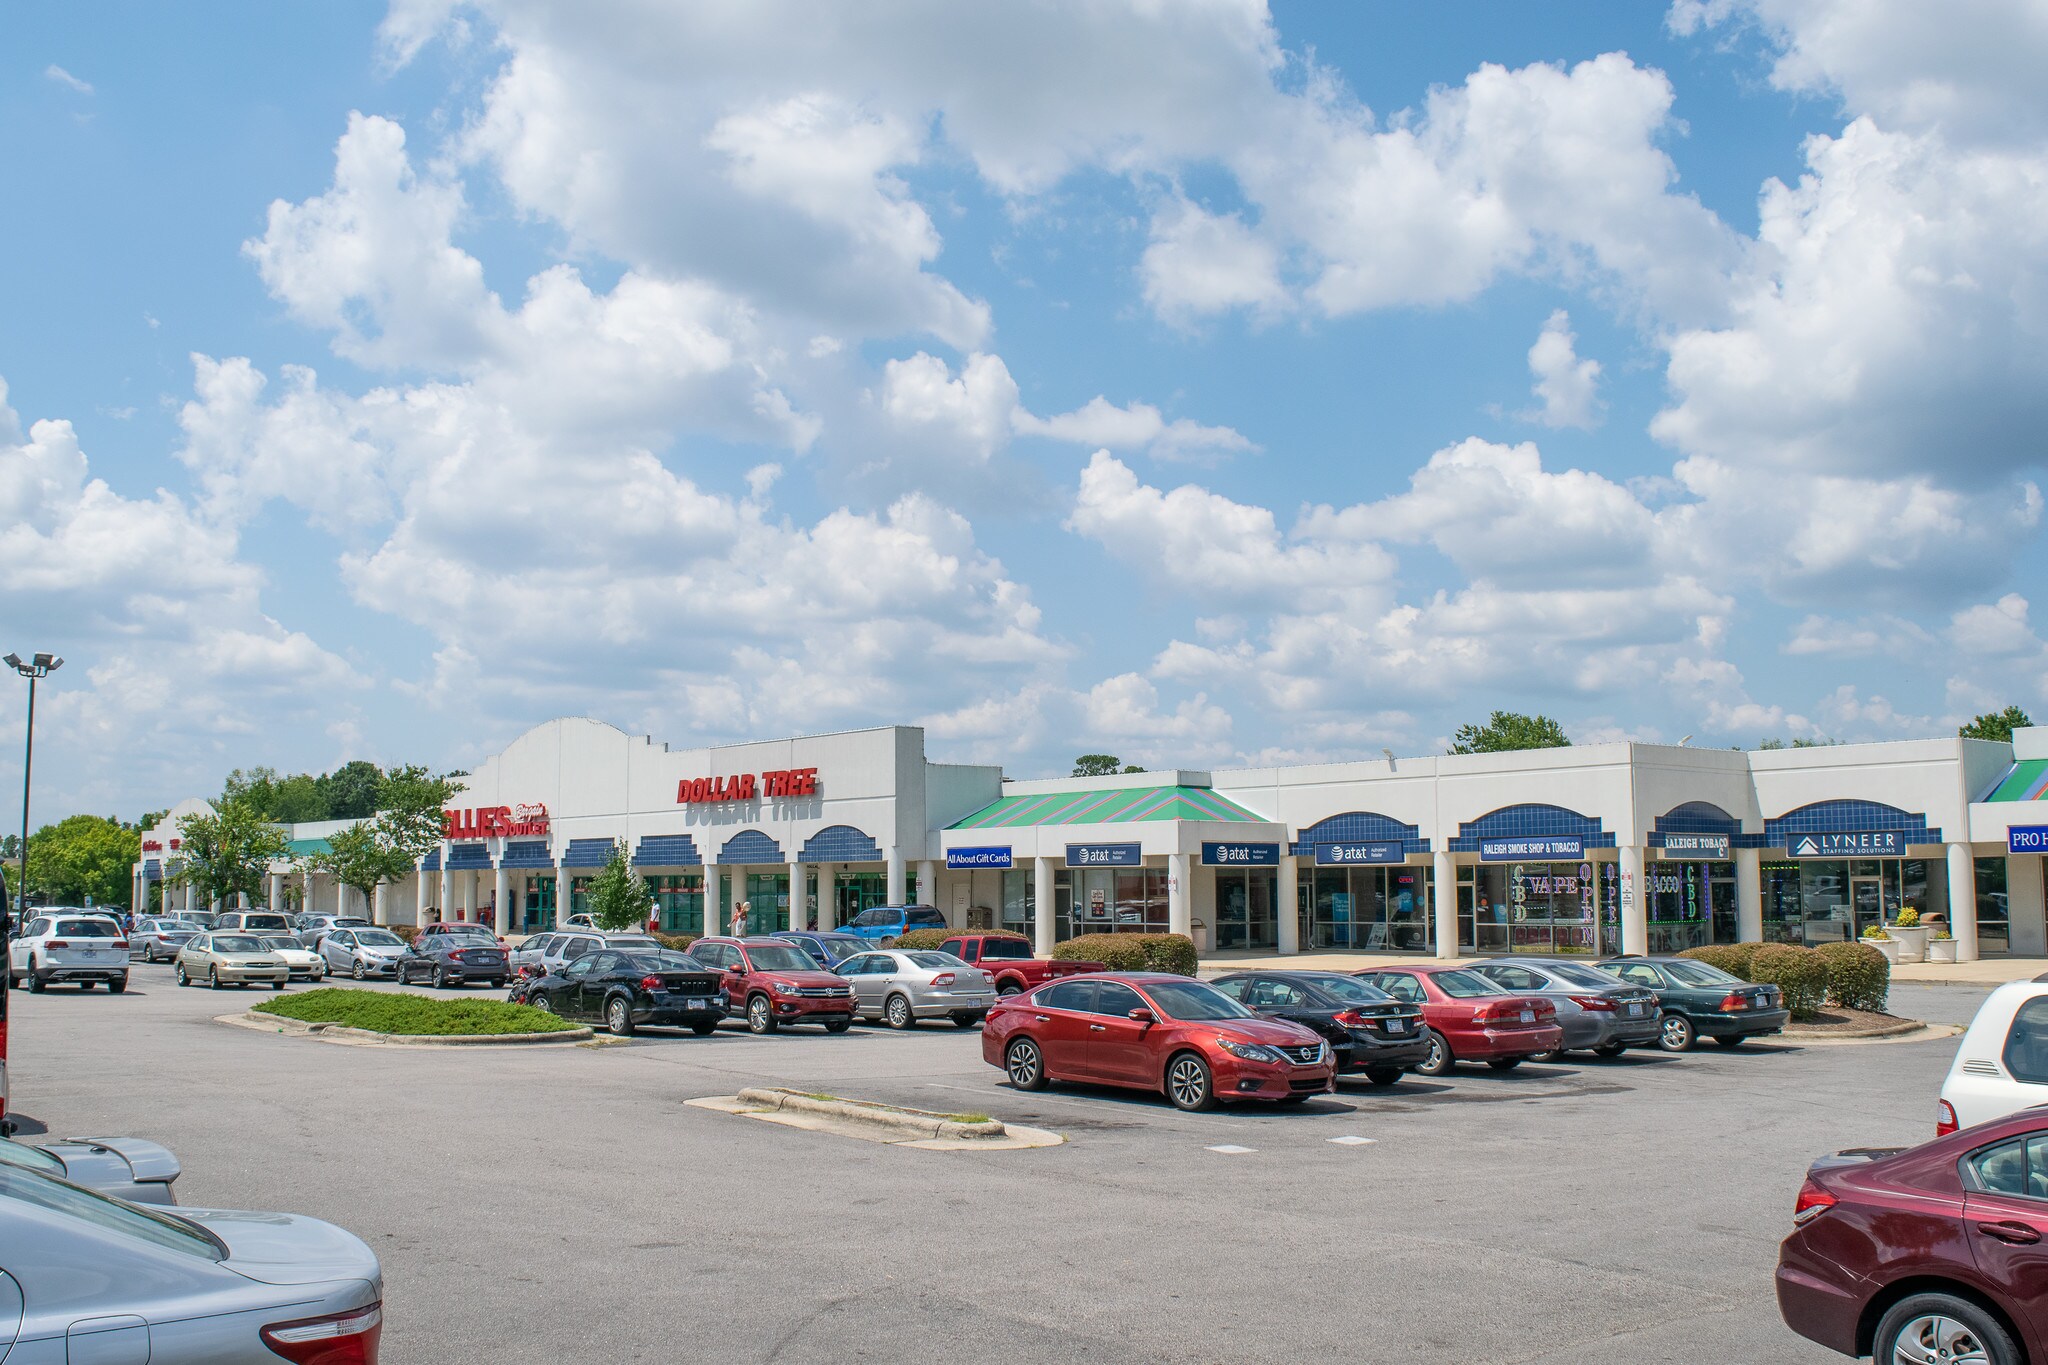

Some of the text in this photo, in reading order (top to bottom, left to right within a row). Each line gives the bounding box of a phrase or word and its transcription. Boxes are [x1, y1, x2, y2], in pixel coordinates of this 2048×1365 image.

[677, 768, 817, 803] DOLLAR TREE
[509, 821, 549, 836] OUTLET
[1822, 834, 1894, 848] LYNEER
[2012, 832, 2040, 846] PRO
[1090, 849, 1109, 861] at&t
[1229, 847, 1249, 860] at&t
[1344, 847, 1367, 859] at&t
[1483, 842, 1580, 854] RALEIGH SMOKE SHOP & TOBACCO
[948, 853, 1010, 863] All About Gift Cards
[1528, 877, 1579, 894] VAPE
[1645, 875, 1679, 893] BACCO
[1513, 865, 1528, 922] CBD
[1687, 866, 1696, 918] CBD
[1579, 863, 1595, 946] OPEN
